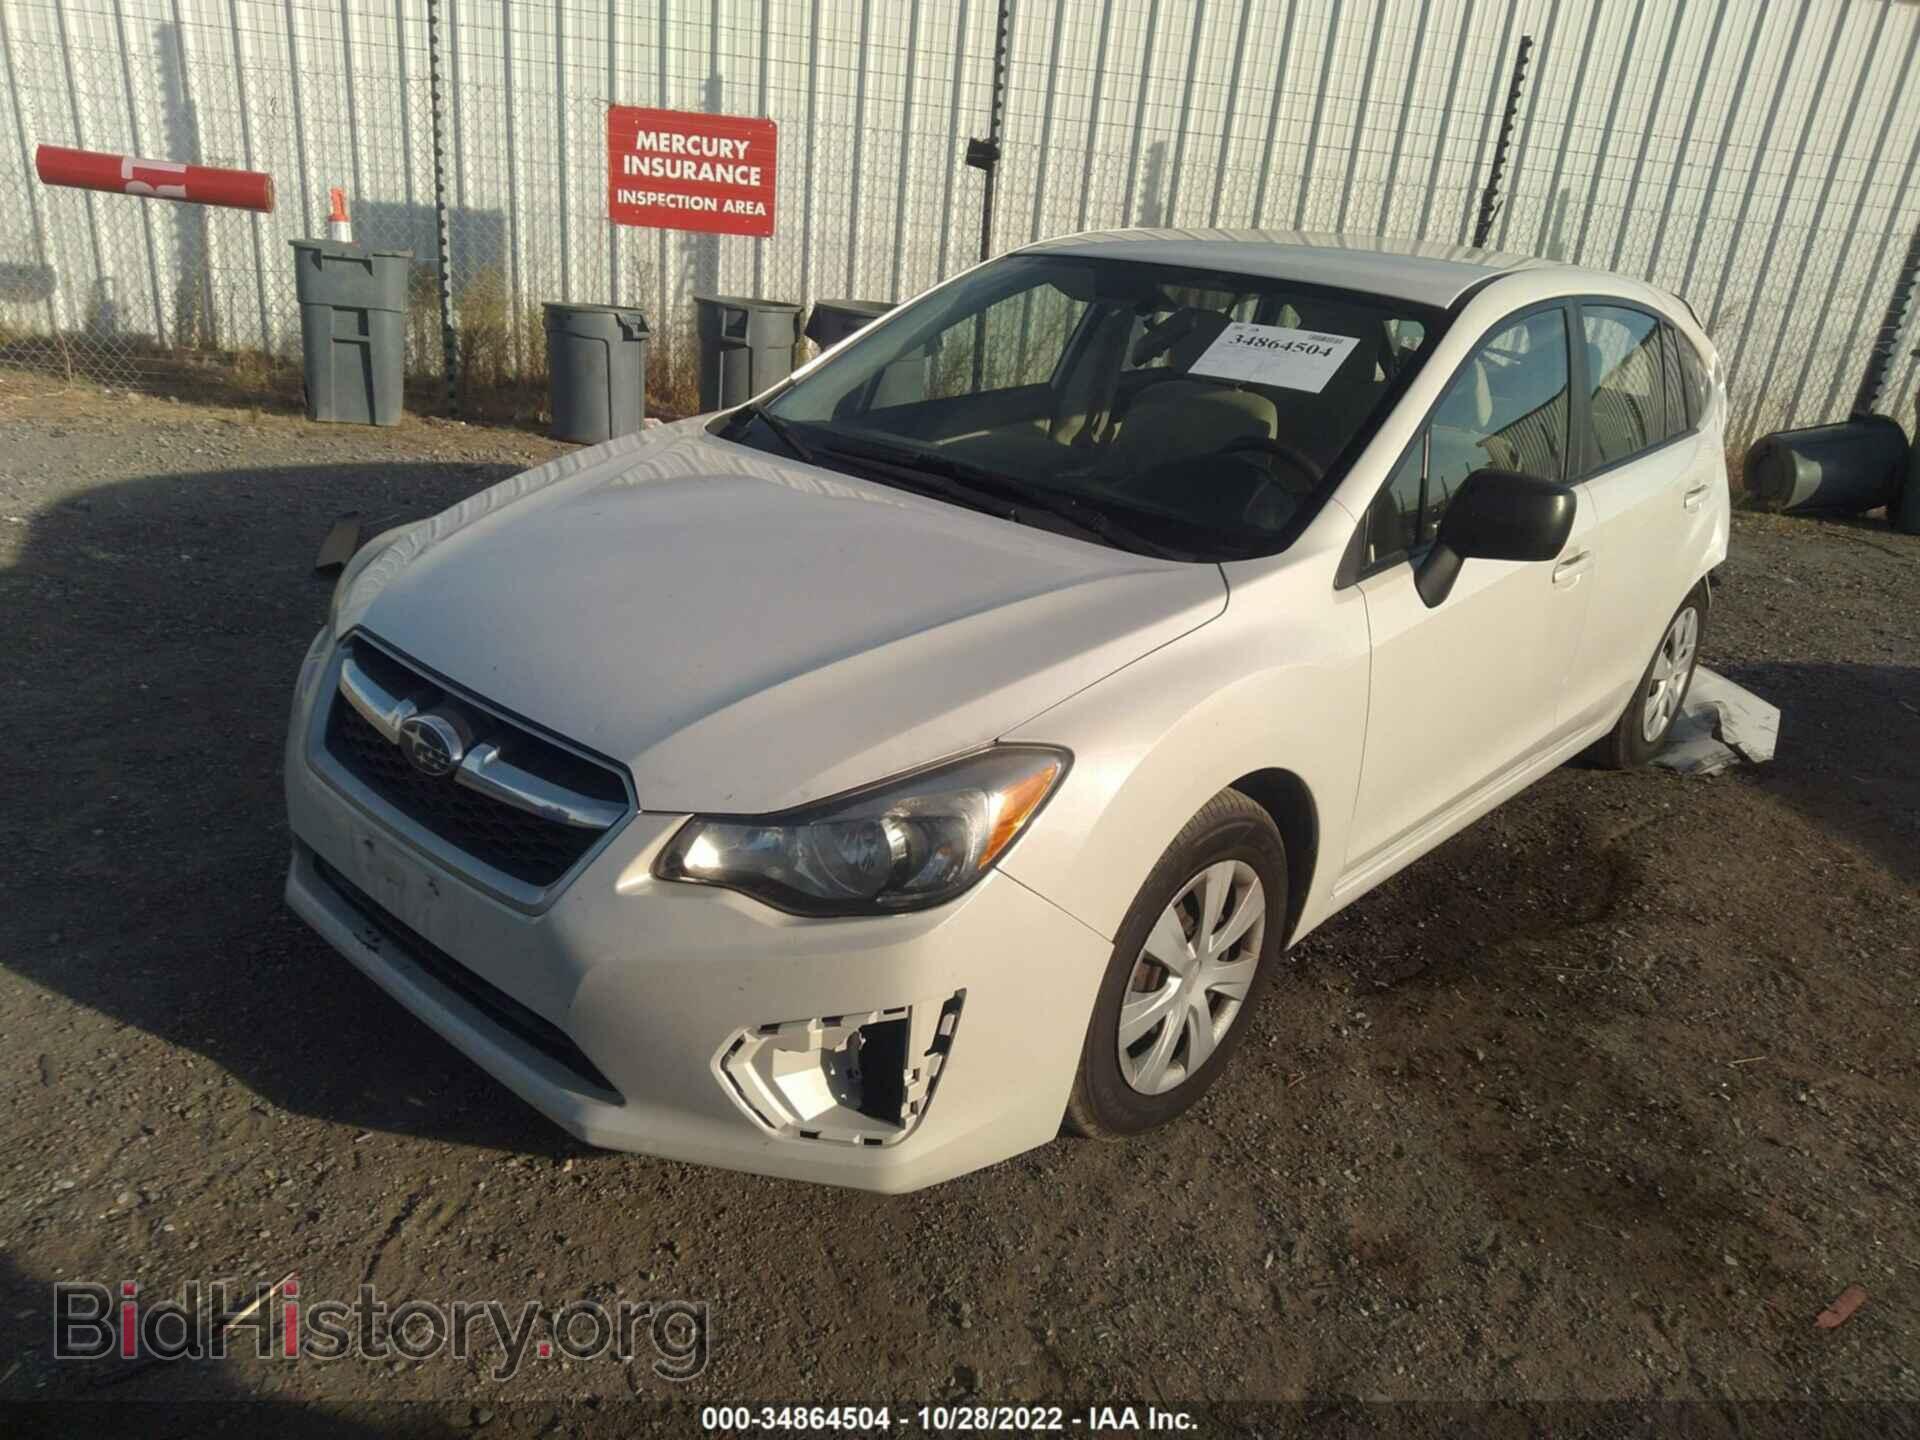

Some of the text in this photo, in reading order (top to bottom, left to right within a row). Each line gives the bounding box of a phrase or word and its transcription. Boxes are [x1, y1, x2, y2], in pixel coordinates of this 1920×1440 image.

[635, 130, 751, 160] MERCURY
[623, 154, 762, 187] INSURANCE
[616, 188, 767, 217] INSPECTION AREA
[1227, 333, 1334, 358] 34864504
